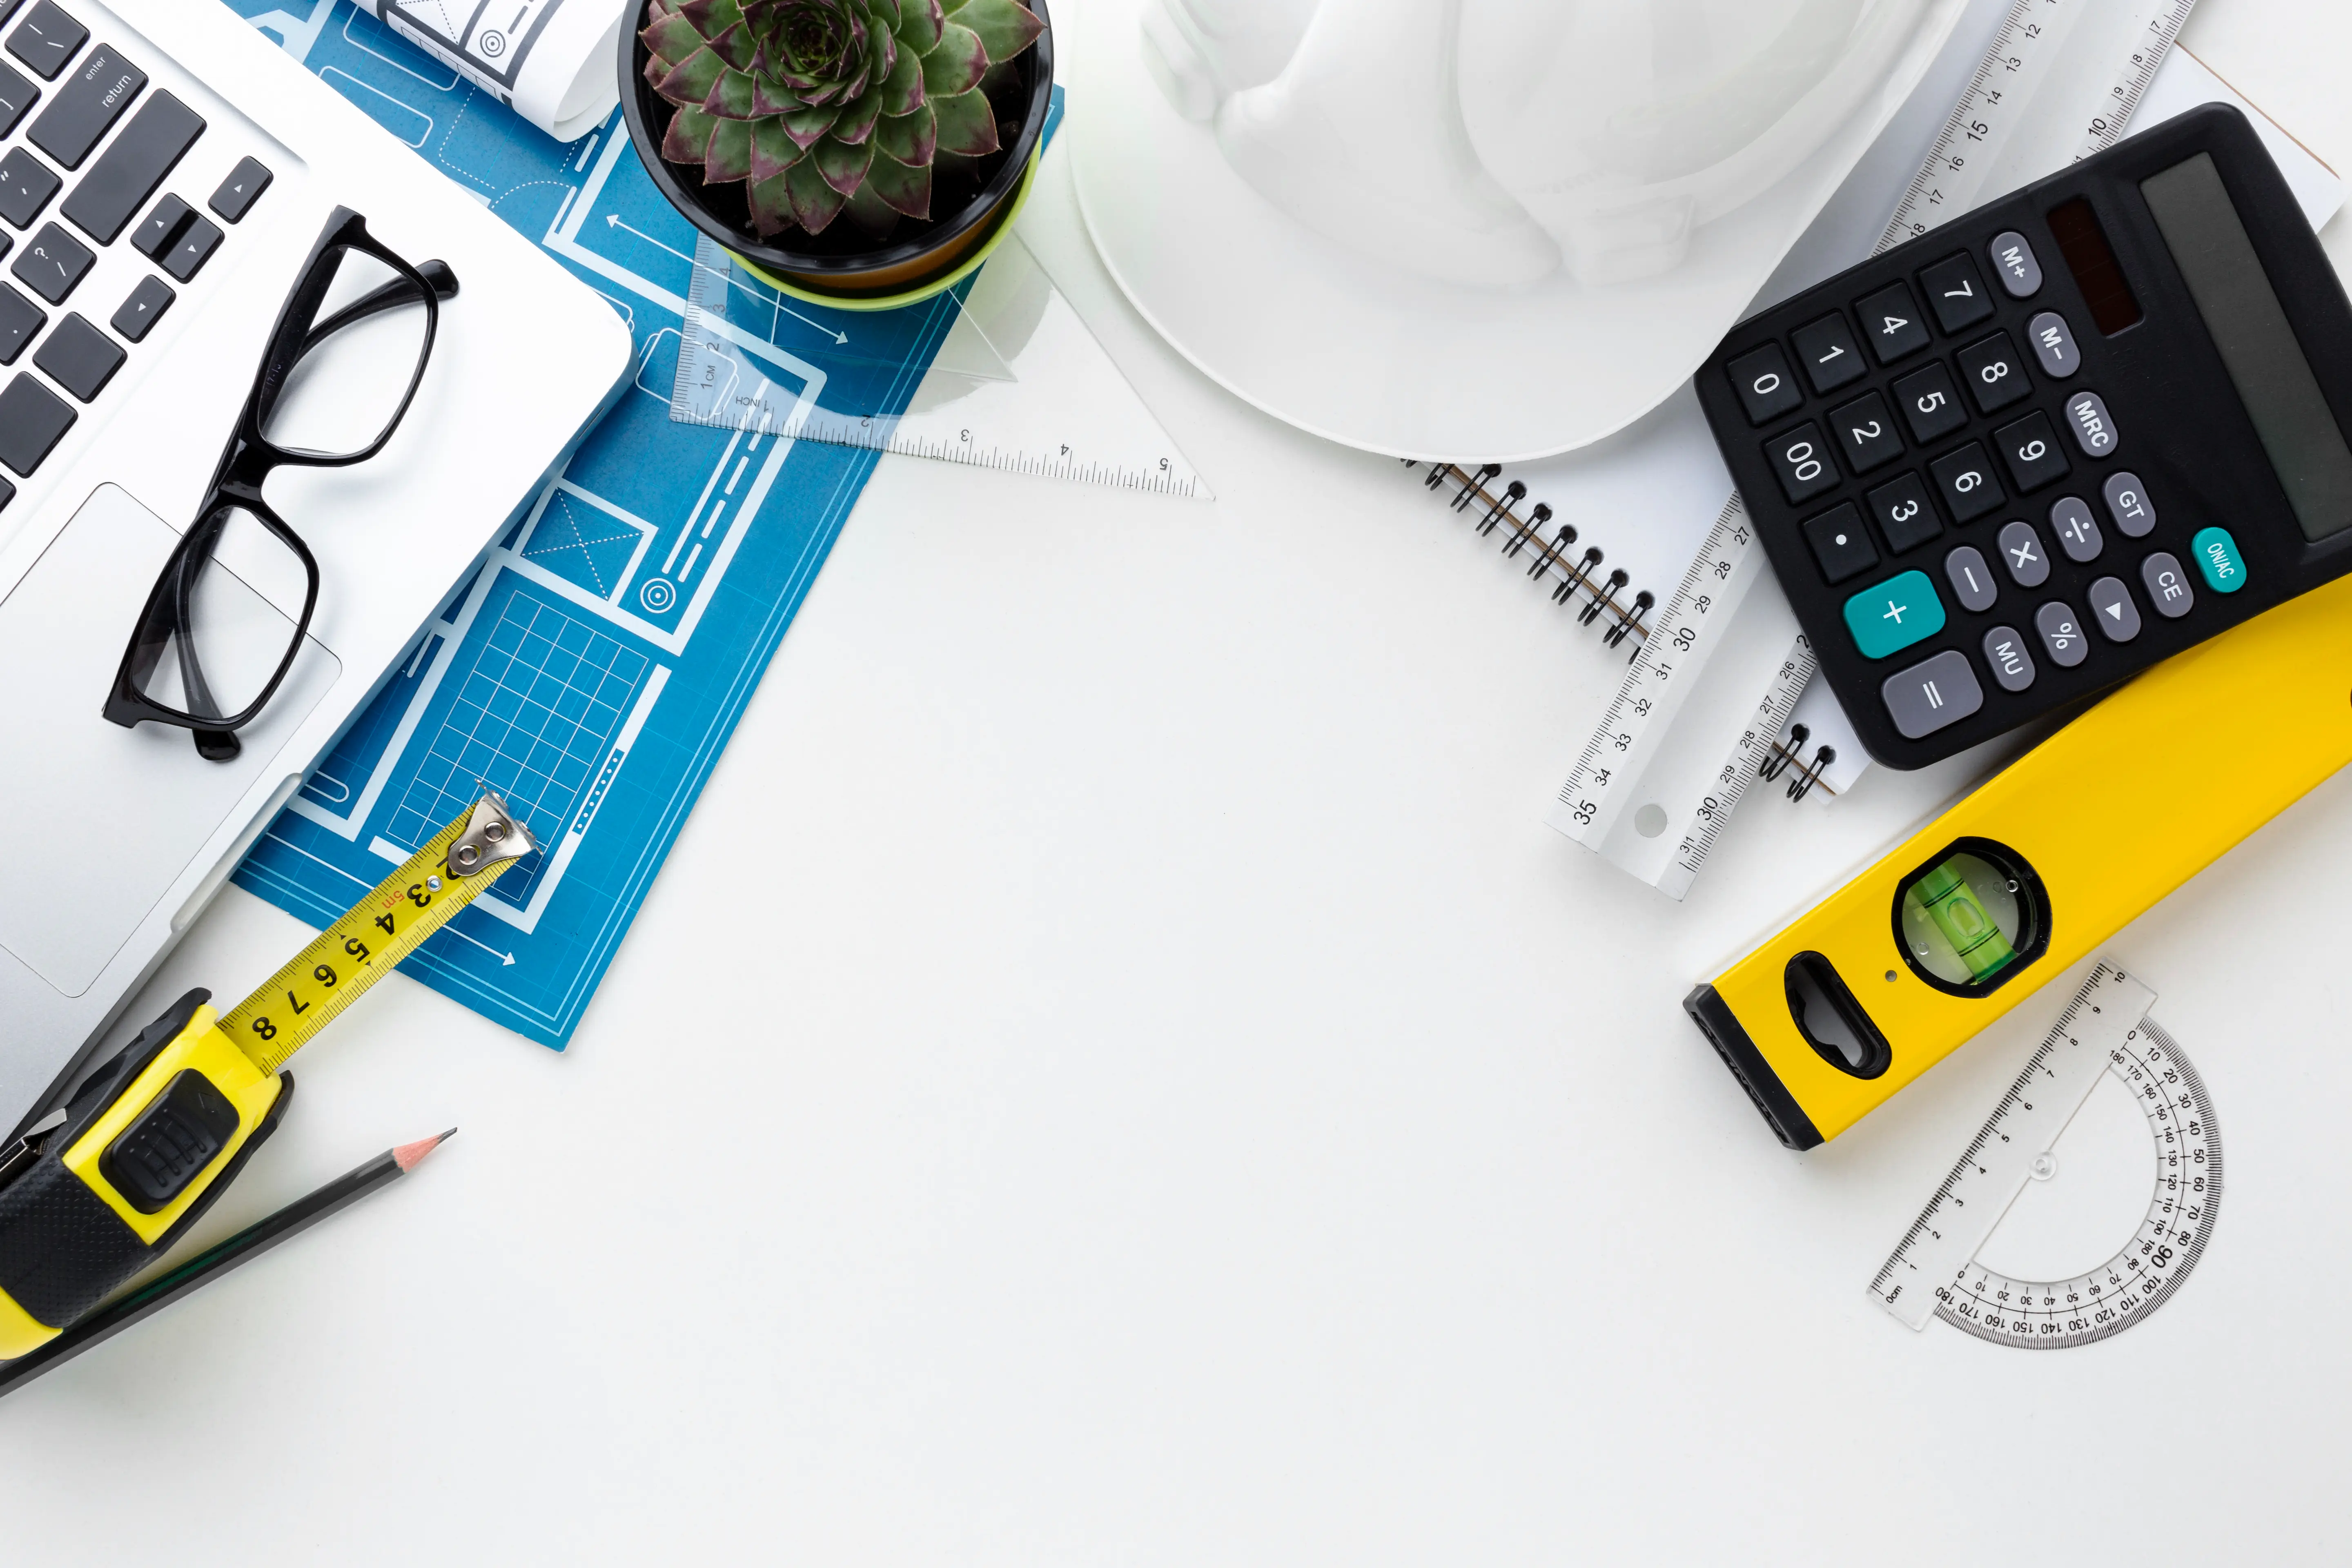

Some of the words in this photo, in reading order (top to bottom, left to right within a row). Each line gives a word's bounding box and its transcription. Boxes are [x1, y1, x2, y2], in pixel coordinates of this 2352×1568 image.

[2025, 24, 2040, 38] 12
[2151, 20, 2160, 29] 7
[86, 57, 105, 79] enter
[2006, 58, 2020, 71] 13
[102, 75, 131, 107] return
[1987, 91, 2002, 105] 14
[1967, 120, 1988, 141] 15
[2088, 118, 2107, 137] 10
[1949, 157, 1964, 171] 16
[1930, 189, 1943, 204] 17
[1911, 223, 1926, 237] 18
[35, 247, 48, 259] ?
[2002, 247, 2025, 277] M+
[719, 267, 729, 276] 4
[1944, 280, 1973, 297] 7
[713, 304, 726, 312] 3
[1883, 317, 1908, 334] 4
[706, 342, 719, 352] 2
[1820, 346, 1844, 363] 1
[706, 365, 715, 381] CM
[1982, 362, 2007, 383] 8
[1754, 374, 1779, 394] 0
[736, 396, 760, 407] INCH
[764, 400, 769, 412] 1
[1918, 392, 1945, 412] 5
[861, 414, 871, 428] 2
[2075, 401, 2108, 447] MRC
[960, 429, 969, 441] 3
[1852, 421, 1880, 444] 2
[1060, 444, 1069, 455] 4
[2019, 441, 2045, 461] 9
[1159, 458, 1169, 470] 5
[1787, 443, 1821, 480] 00
[1956, 472, 1981, 492] 6
[1892, 501, 1918, 521] 3
[2120, 491, 2144, 517] GT
[1735, 526, 1749, 545] 27
[2207, 543, 2234, 578] ON/AC
[1715, 561, 1731, 579] 28
[2159, 572, 2182, 601] CE
[1695, 596, 1711, 614] 29
[1674, 627, 1696, 652] 30
[2051, 623, 2076, 649] %
[1996, 641, 2023, 674] MU
[1656, 664, 1671, 679] 31
[1780, 662, 1795, 679] 26
[1635, 699, 1652, 716] 32
[1760, 696, 1774, 713] 27
[1615, 734, 1631, 751] 33
[1740, 731, 1755, 748] 28
[1595, 768, 1611, 786] 34
[1720, 766, 1735, 784] 29
[1574, 800, 1596, 824] 35
[1697, 797, 1718, 821] 30
[1679, 836, 1695, 854] 31
[384, 890, 405, 909] 5m
[407, 884, 431, 907] 3
[375, 913, 394, 935] 4
[345, 938, 370, 962] 5
[314, 964, 337, 987] 6
[2114, 972, 2125, 983] 10
[287, 991, 310, 1015] 7
[252, 1017, 276, 1040] 8
[2127, 1030, 2136, 1040] 0
[2070, 1038, 2078, 1046] 8
[2109, 1050, 2125, 1064] 180
[2147, 1047, 2160, 1061] 10
[2127, 1065, 2142, 1080] 170
[2163, 1068, 2178, 1084] 20
[2143, 1083, 2156, 1099] 160
[2178, 1093, 2192, 1109] 30
[2155, 1103, 2167, 1120] 150
[2163, 1126, 2174, 1143] 140
[2189, 1120, 2201, 1136] 40
[2001, 1134, 2009, 1143] 5
[2168, 1149, 2177, 1167] 130
[2194, 1149, 2205, 1163] 50
[2168, 1174, 2177, 1190] 120
[2193, 1177, 2205, 1192] 60
[2163, 1198, 2174, 1213] 110
[2187, 1205, 2201, 1220] 70
[2154, 1219, 2166, 1235] 100
[1932, 1231, 1941, 1240] 2
[2178, 1231, 2191, 1246] 80
[2127, 1258, 2139, 1270] 80
[2151, 1245, 2173, 1268] 90
[1958, 1270, 1965, 1279] 0
[2109, 1274, 2122, 1285] 70
[1975, 1281, 1986, 1292] 10
[2089, 1285, 2101, 1296] 60
[2142, 1275, 2161, 1294] 100
[1886, 1285, 1902, 1304] 0cm
[1935, 1287, 1955, 1305] 180
[1997, 1291, 2010, 1301] 20
[2020, 1296, 2032, 1305] 30
[2044, 1297, 2056, 1306] 40
[2067, 1293, 2078, 1303] 50
[2120, 1294, 2140, 1311] 110
[1959, 1303, 1978, 1319] 170
[2095, 1308, 2116, 1323] 120
[1985, 1314, 2005, 1329] 160
[2013, 1321, 2034, 1333] 150
[2041, 1323, 2062, 1334] 140
[2069, 1317, 2090, 1331] 130
